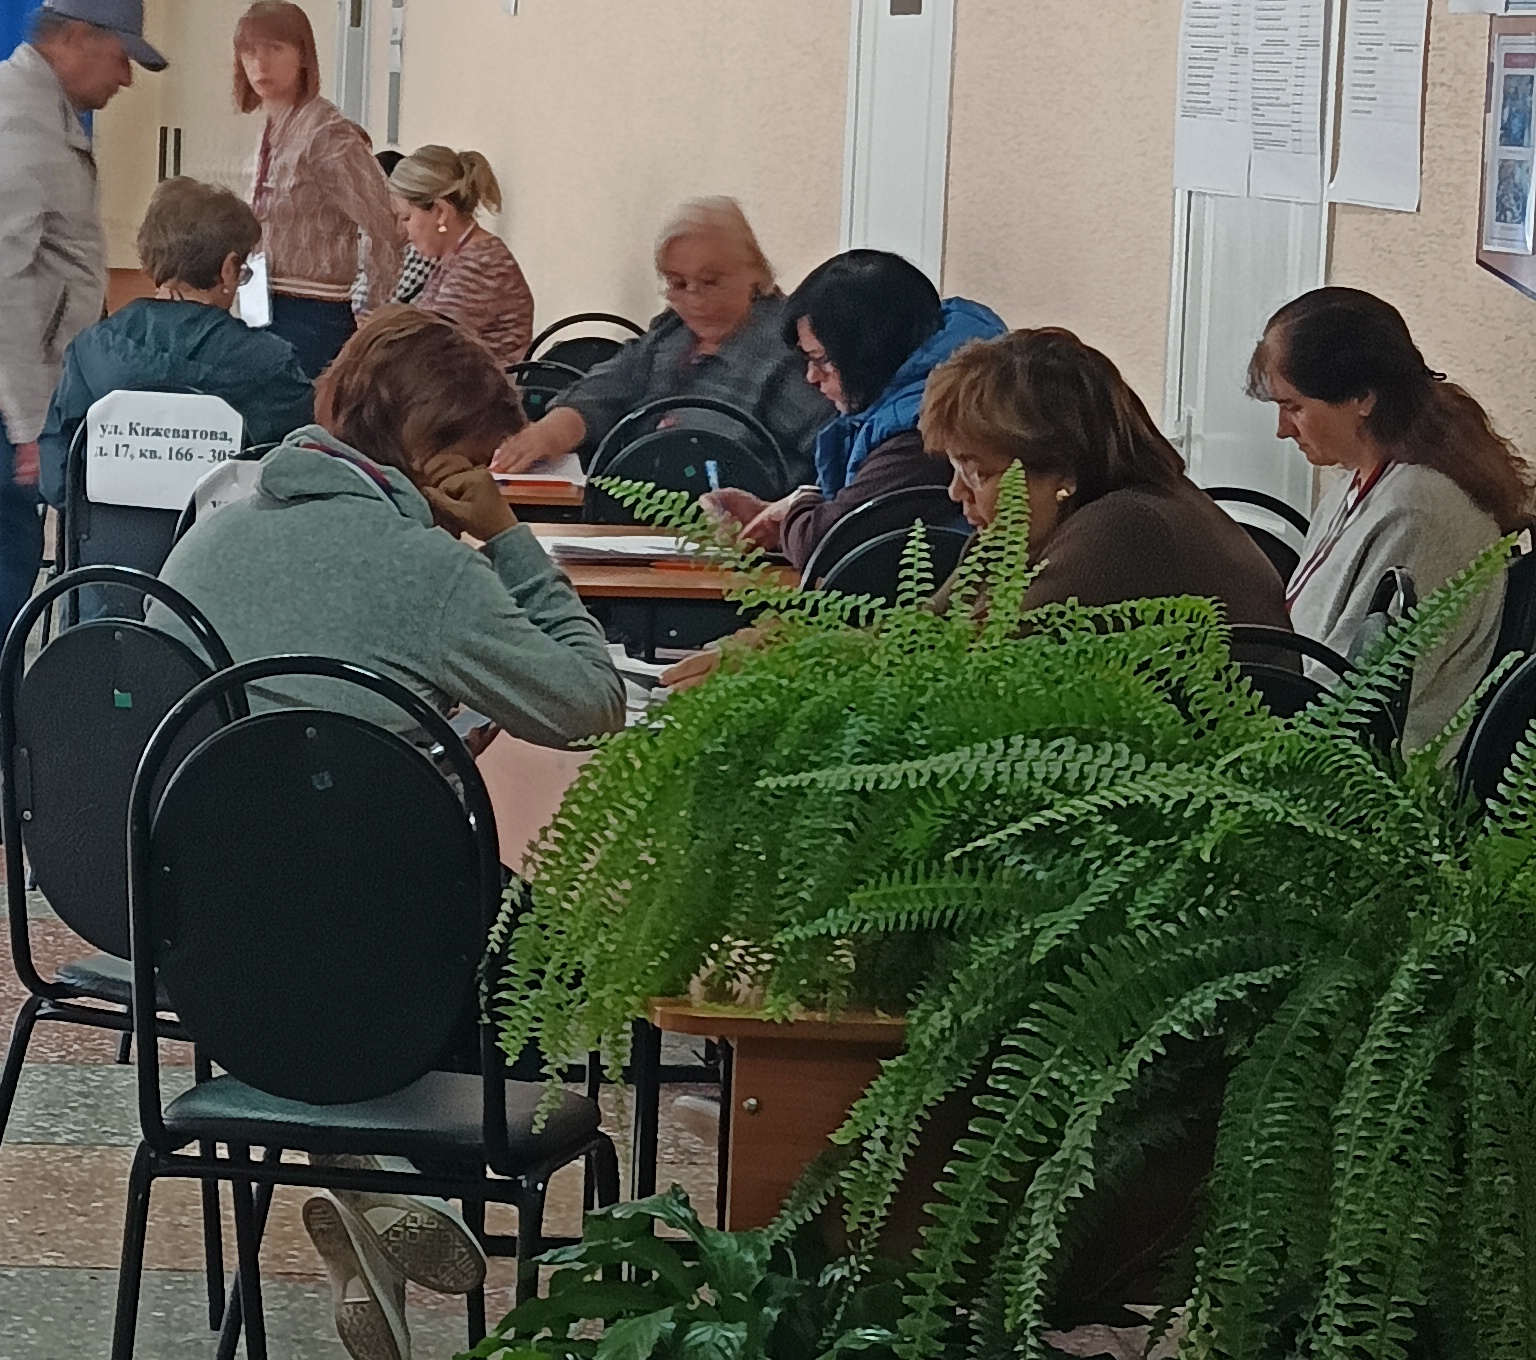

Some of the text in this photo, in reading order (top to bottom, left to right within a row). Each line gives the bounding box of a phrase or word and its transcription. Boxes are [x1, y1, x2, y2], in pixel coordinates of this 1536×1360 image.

[99, 421, 233, 445] ул. Кижеватова,
[93, 445, 108, 458] д.
[114, 443, 135, 461] 17,
[139, 448, 163, 460] кв.
[168, 446, 194, 461] 166
